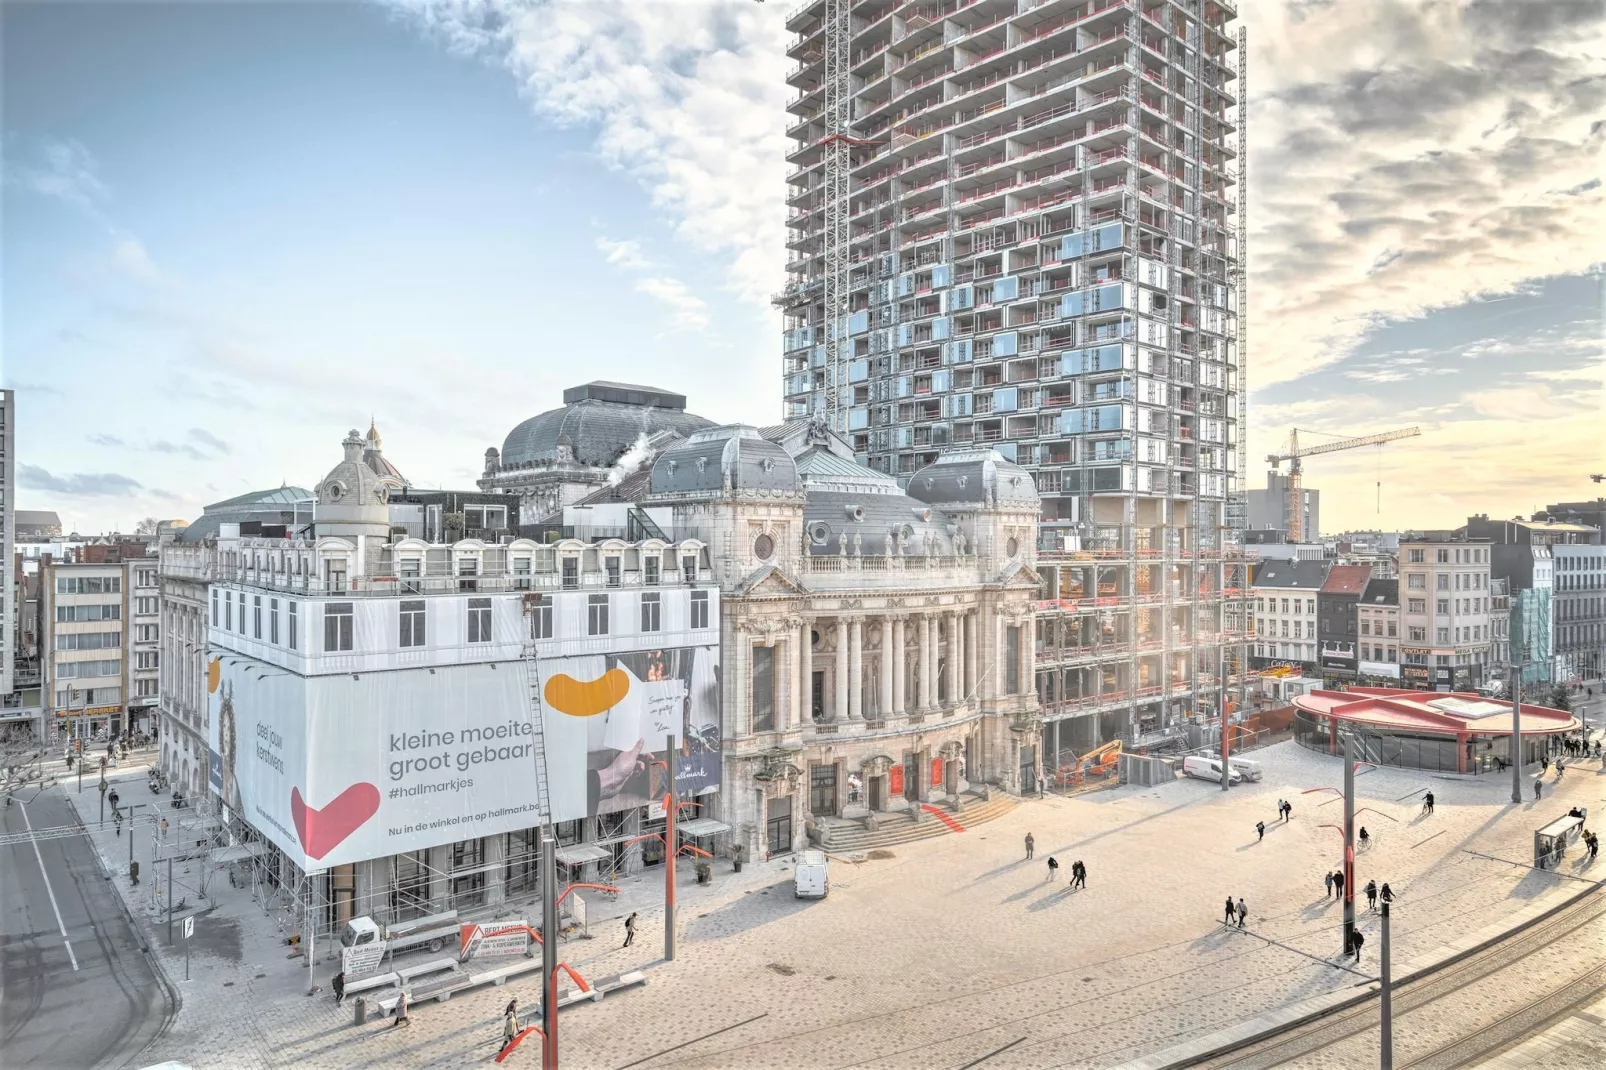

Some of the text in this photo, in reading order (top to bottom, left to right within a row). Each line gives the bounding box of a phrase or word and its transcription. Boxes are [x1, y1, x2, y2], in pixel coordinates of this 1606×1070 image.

[256, 720, 283, 750] deel jouw
[390, 720, 532, 752] kleine moeite
[256, 741, 284, 775] kerstwens
[390, 743, 532, 781] groot gebaar
[675, 767, 708, 780] allmark
[388, 778, 474, 799] #hallmarkjes
[388, 802, 540, 836] Nu in de winkel en op hallmark.be
